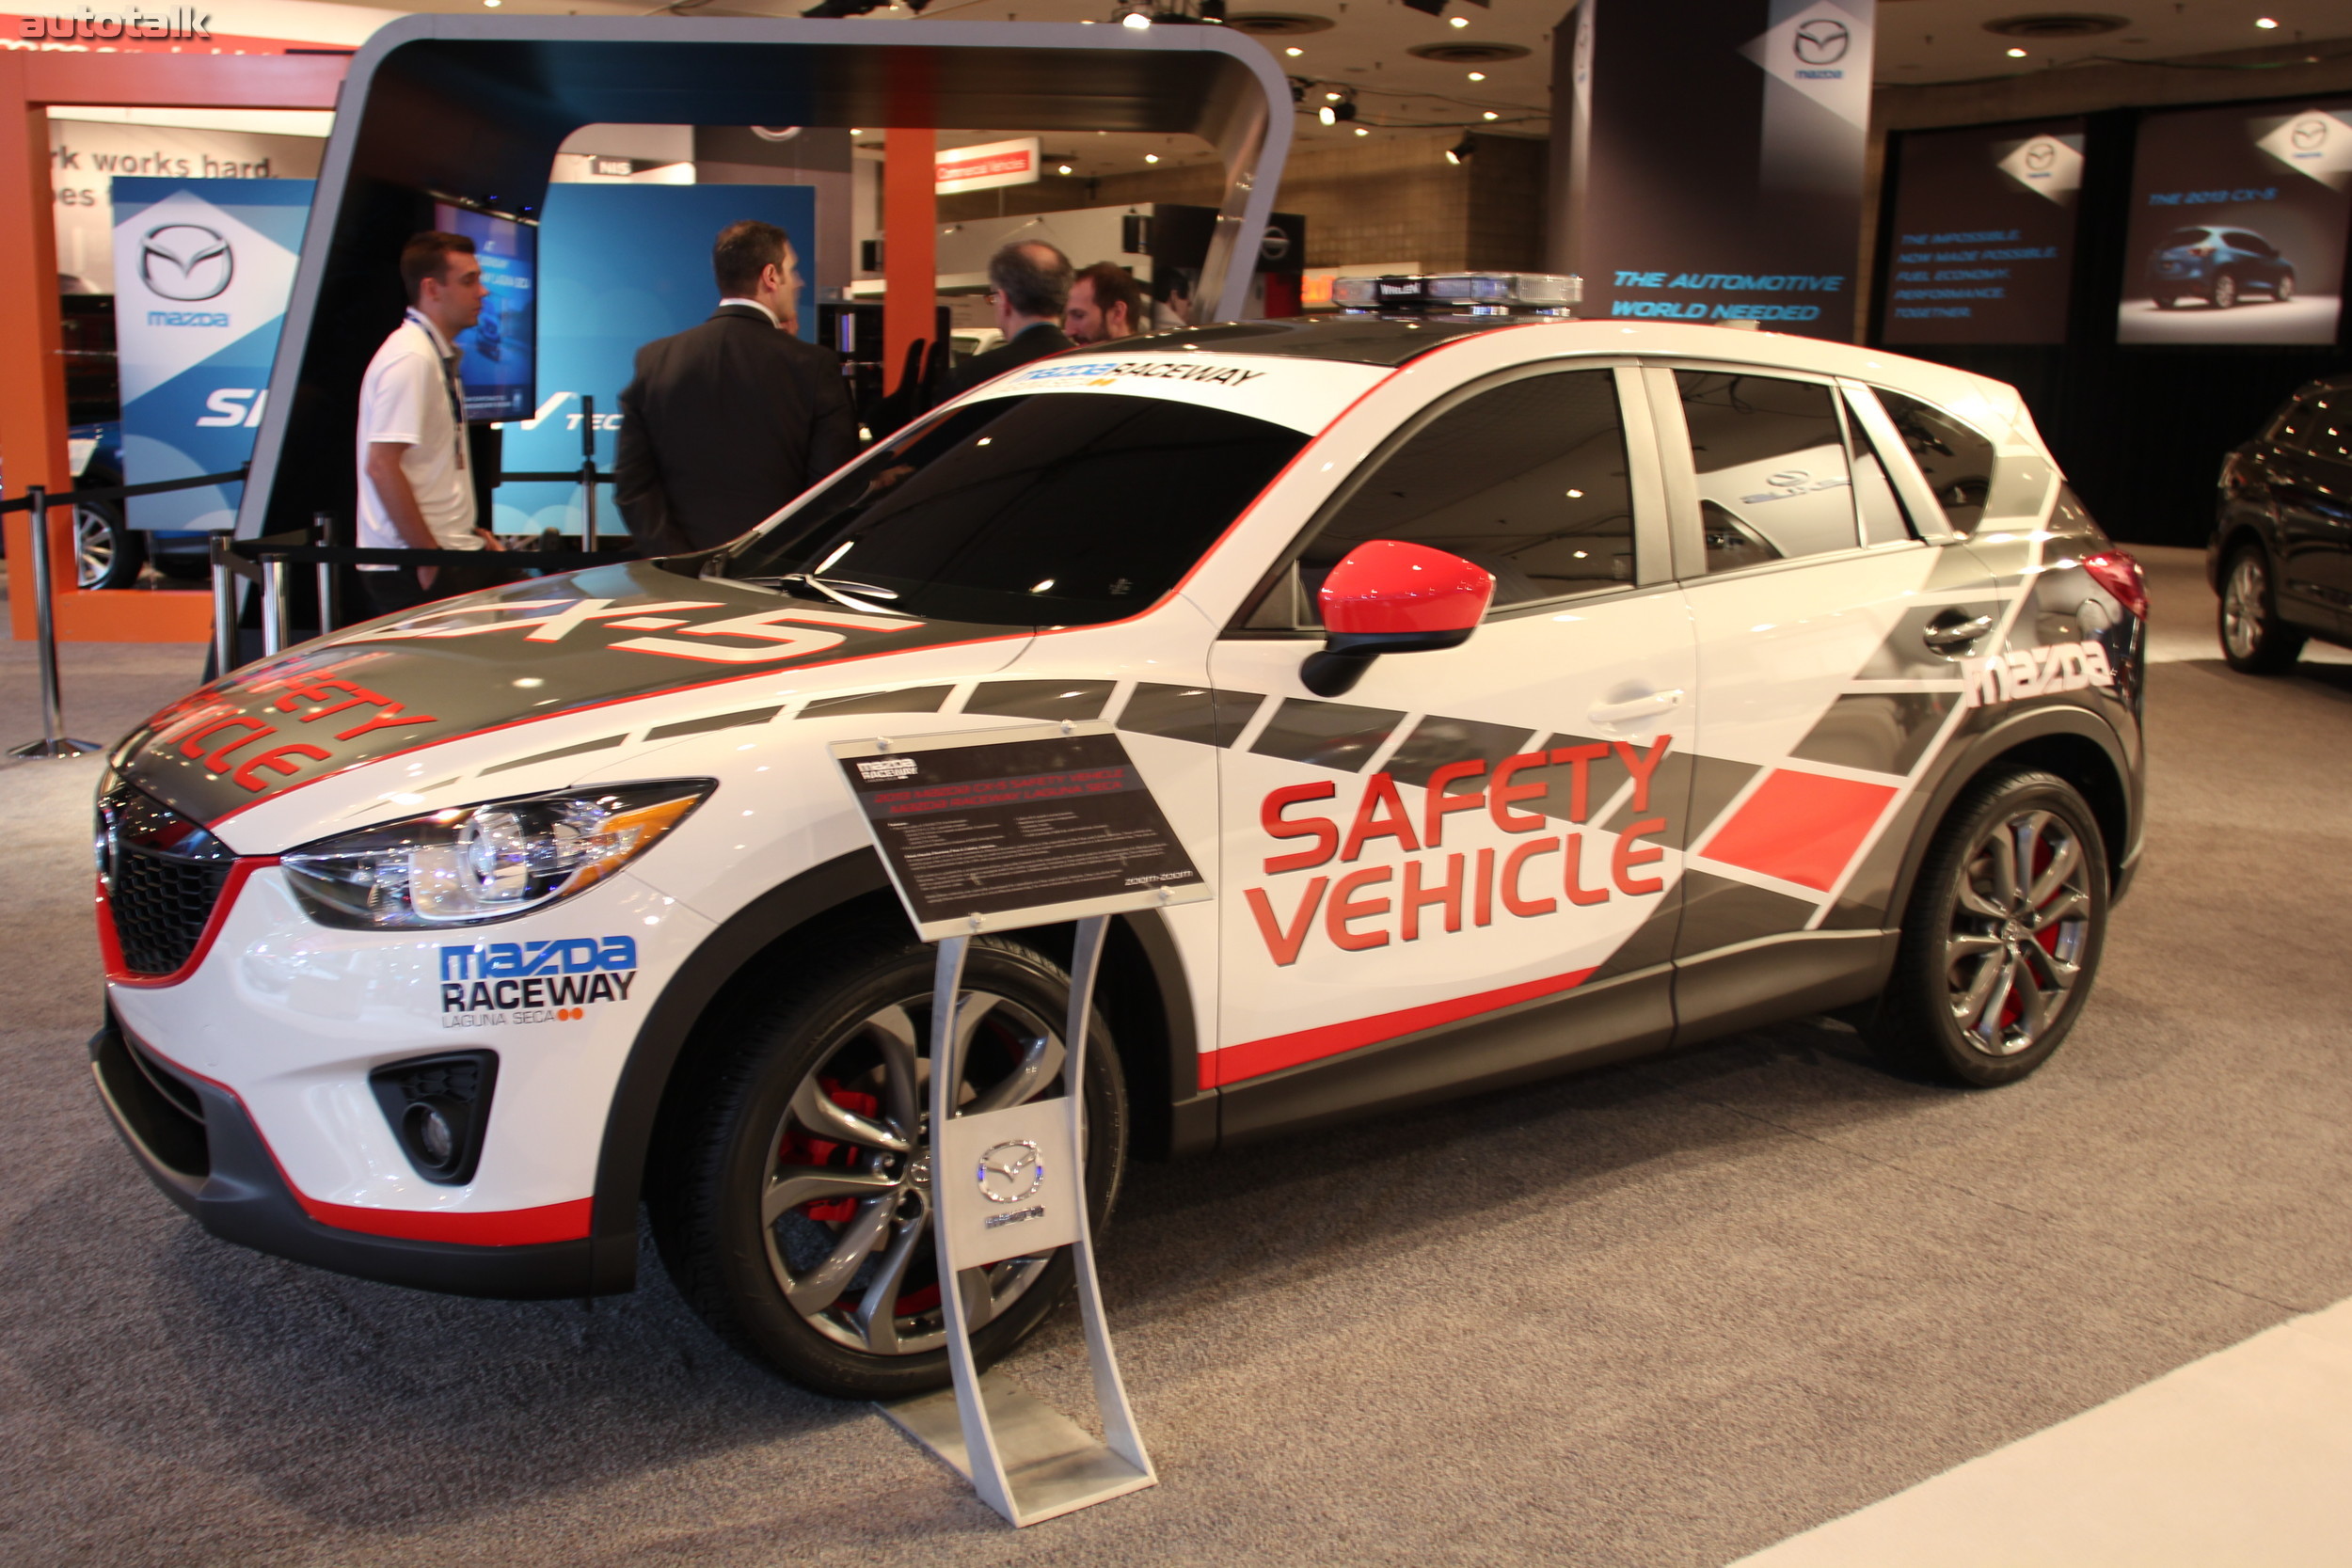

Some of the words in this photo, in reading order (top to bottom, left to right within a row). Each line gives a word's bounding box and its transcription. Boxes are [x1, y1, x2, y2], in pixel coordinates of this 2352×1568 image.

[92, 151, 190, 176] works
[1613, 271, 1668, 288] THE
[1668, 273, 1846, 292] AUTOMOTIVE
[147, 310, 230, 327] mazda
[1612, 301, 1708, 318] WORLD
[1710, 303, 1820, 321] NEEDED
[1101, 363, 1266, 387] RACEWAY
[1960, 640, 2115, 708] mazda
[1261, 734, 1673, 875] SAFETY
[1243, 817, 1667, 968] VEHICLE
[439, 935, 638, 982] mazda
[440, 971, 639, 1013] RACEWAY
[442, 1013, 506, 1030] LAGUNA
[513, 1009, 555, 1026] SECA
